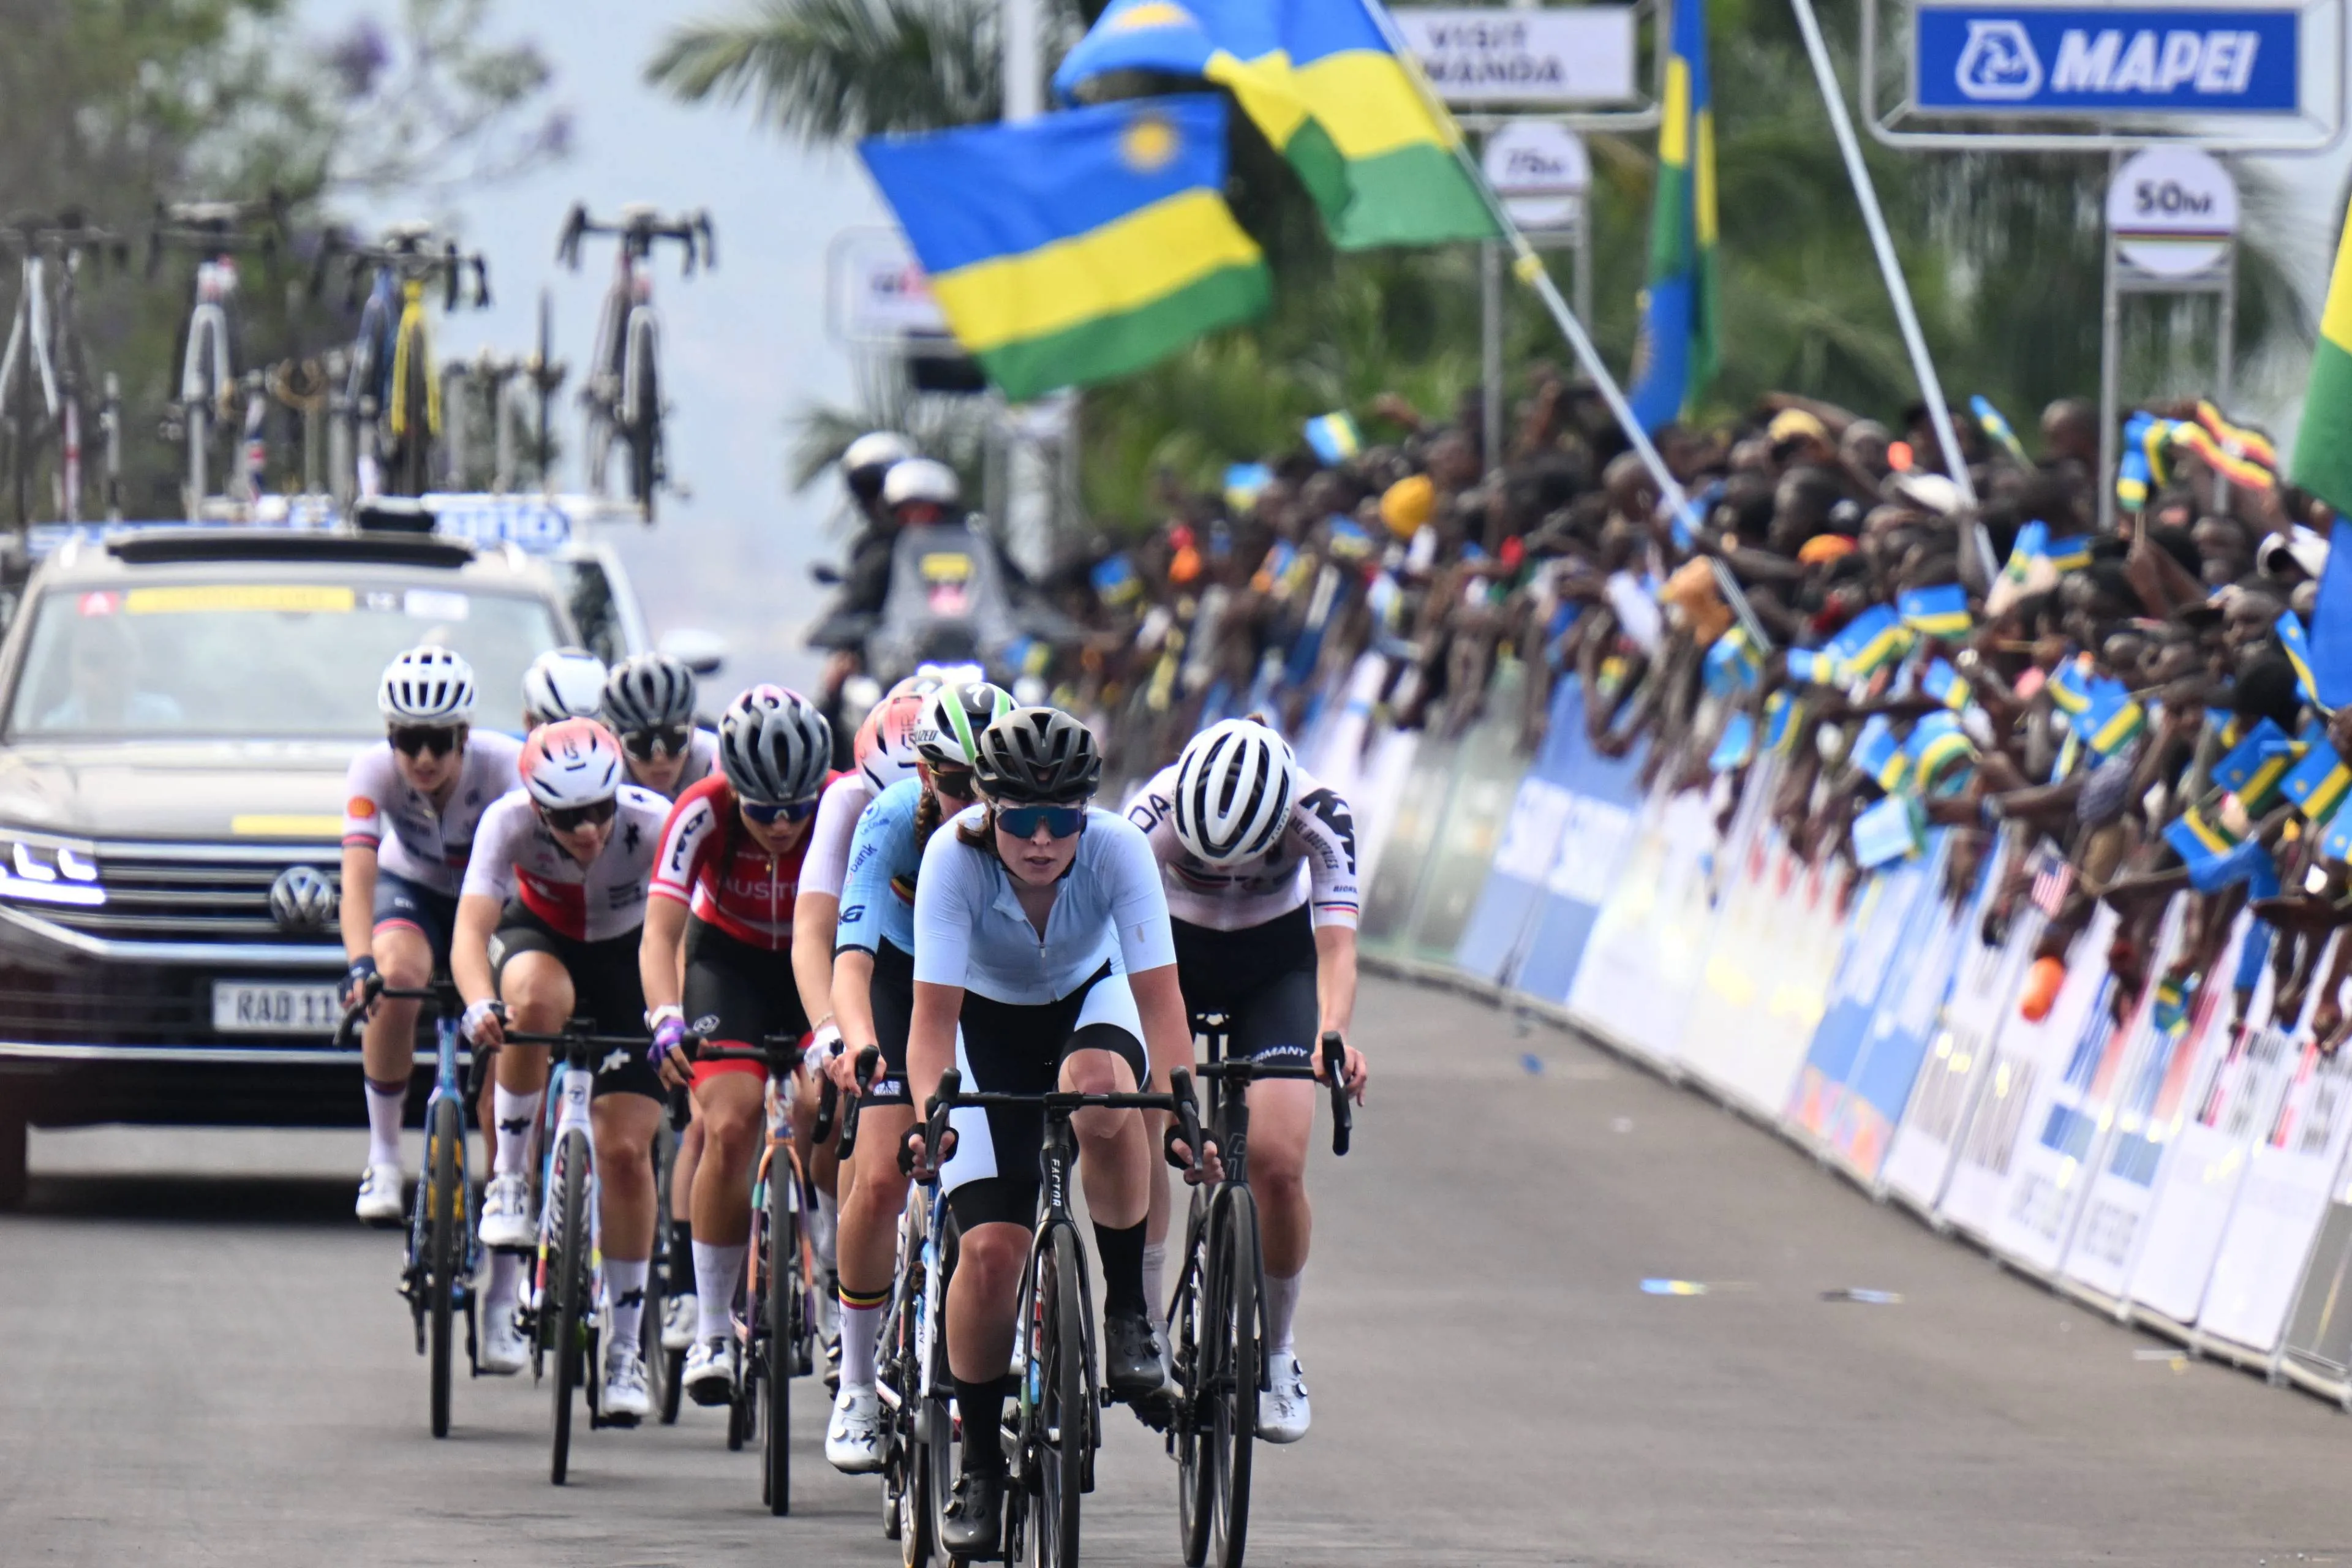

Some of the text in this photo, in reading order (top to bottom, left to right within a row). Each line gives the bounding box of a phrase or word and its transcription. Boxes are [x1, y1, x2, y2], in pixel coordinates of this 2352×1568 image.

[1427, 21, 1528, 49] VISIT
[1422, 53, 1565, 85] WANDA
[2051, 29, 2260, 95] MAPEI
[1128, 794, 1171, 834] DA
[237, 989, 337, 1025] RAD 11
[1051, 1158, 1061, 1207] FACTOR
